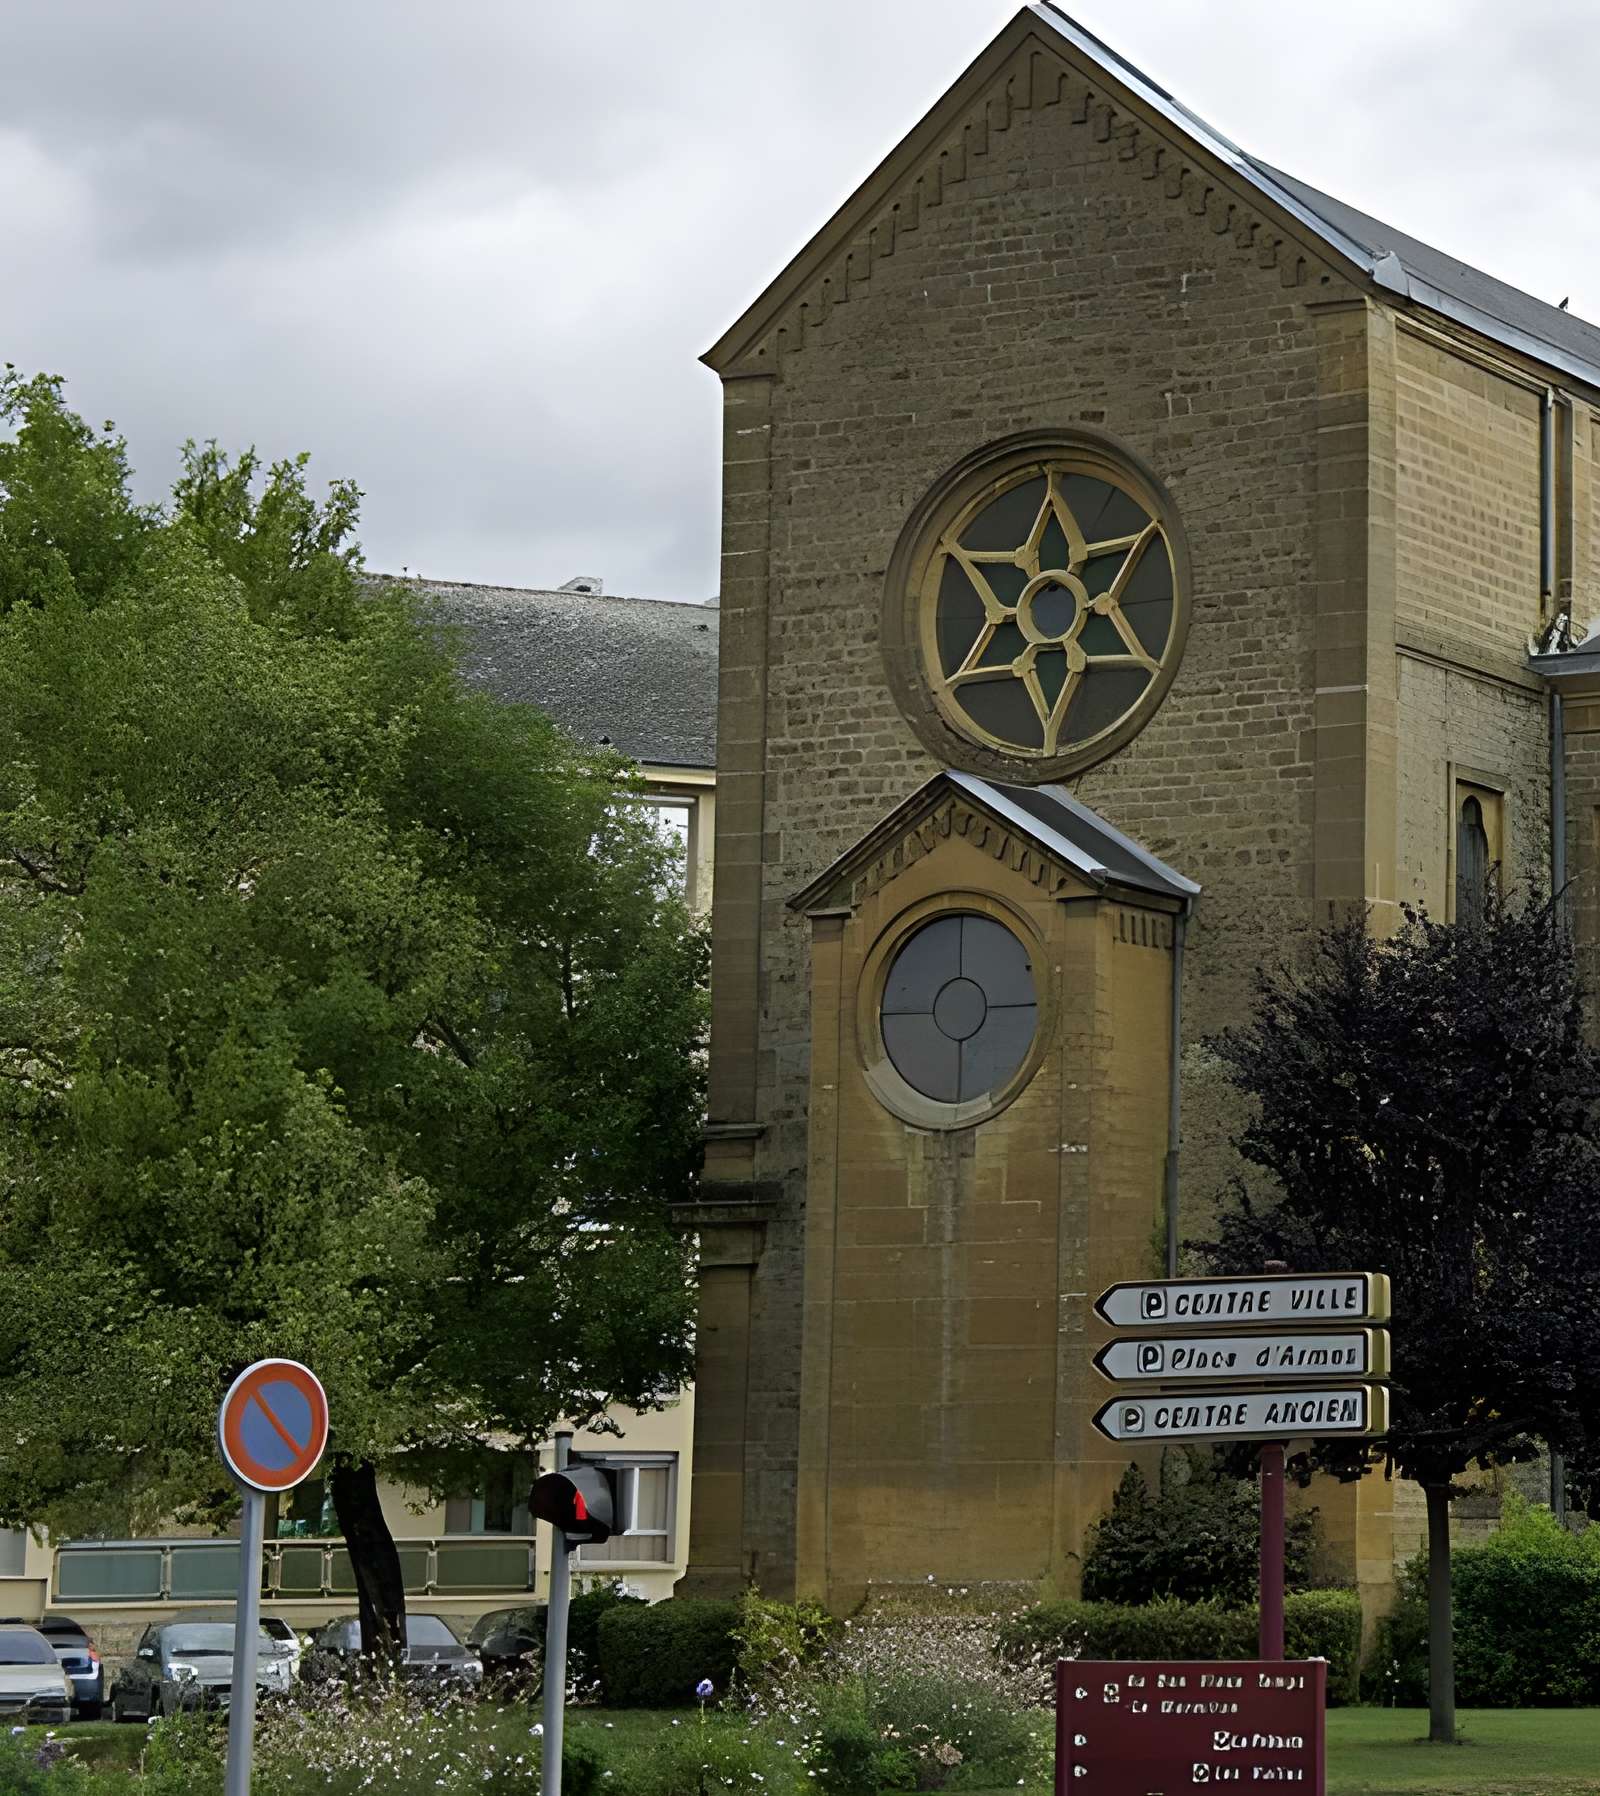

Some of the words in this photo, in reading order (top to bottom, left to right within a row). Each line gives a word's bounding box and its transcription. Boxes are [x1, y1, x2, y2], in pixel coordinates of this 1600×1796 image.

[1291, 1286, 1358, 1310] VILLE
[1154, 1403, 1248, 1429] CENTRE
[1264, 1397, 1358, 1425] ANCIEN
